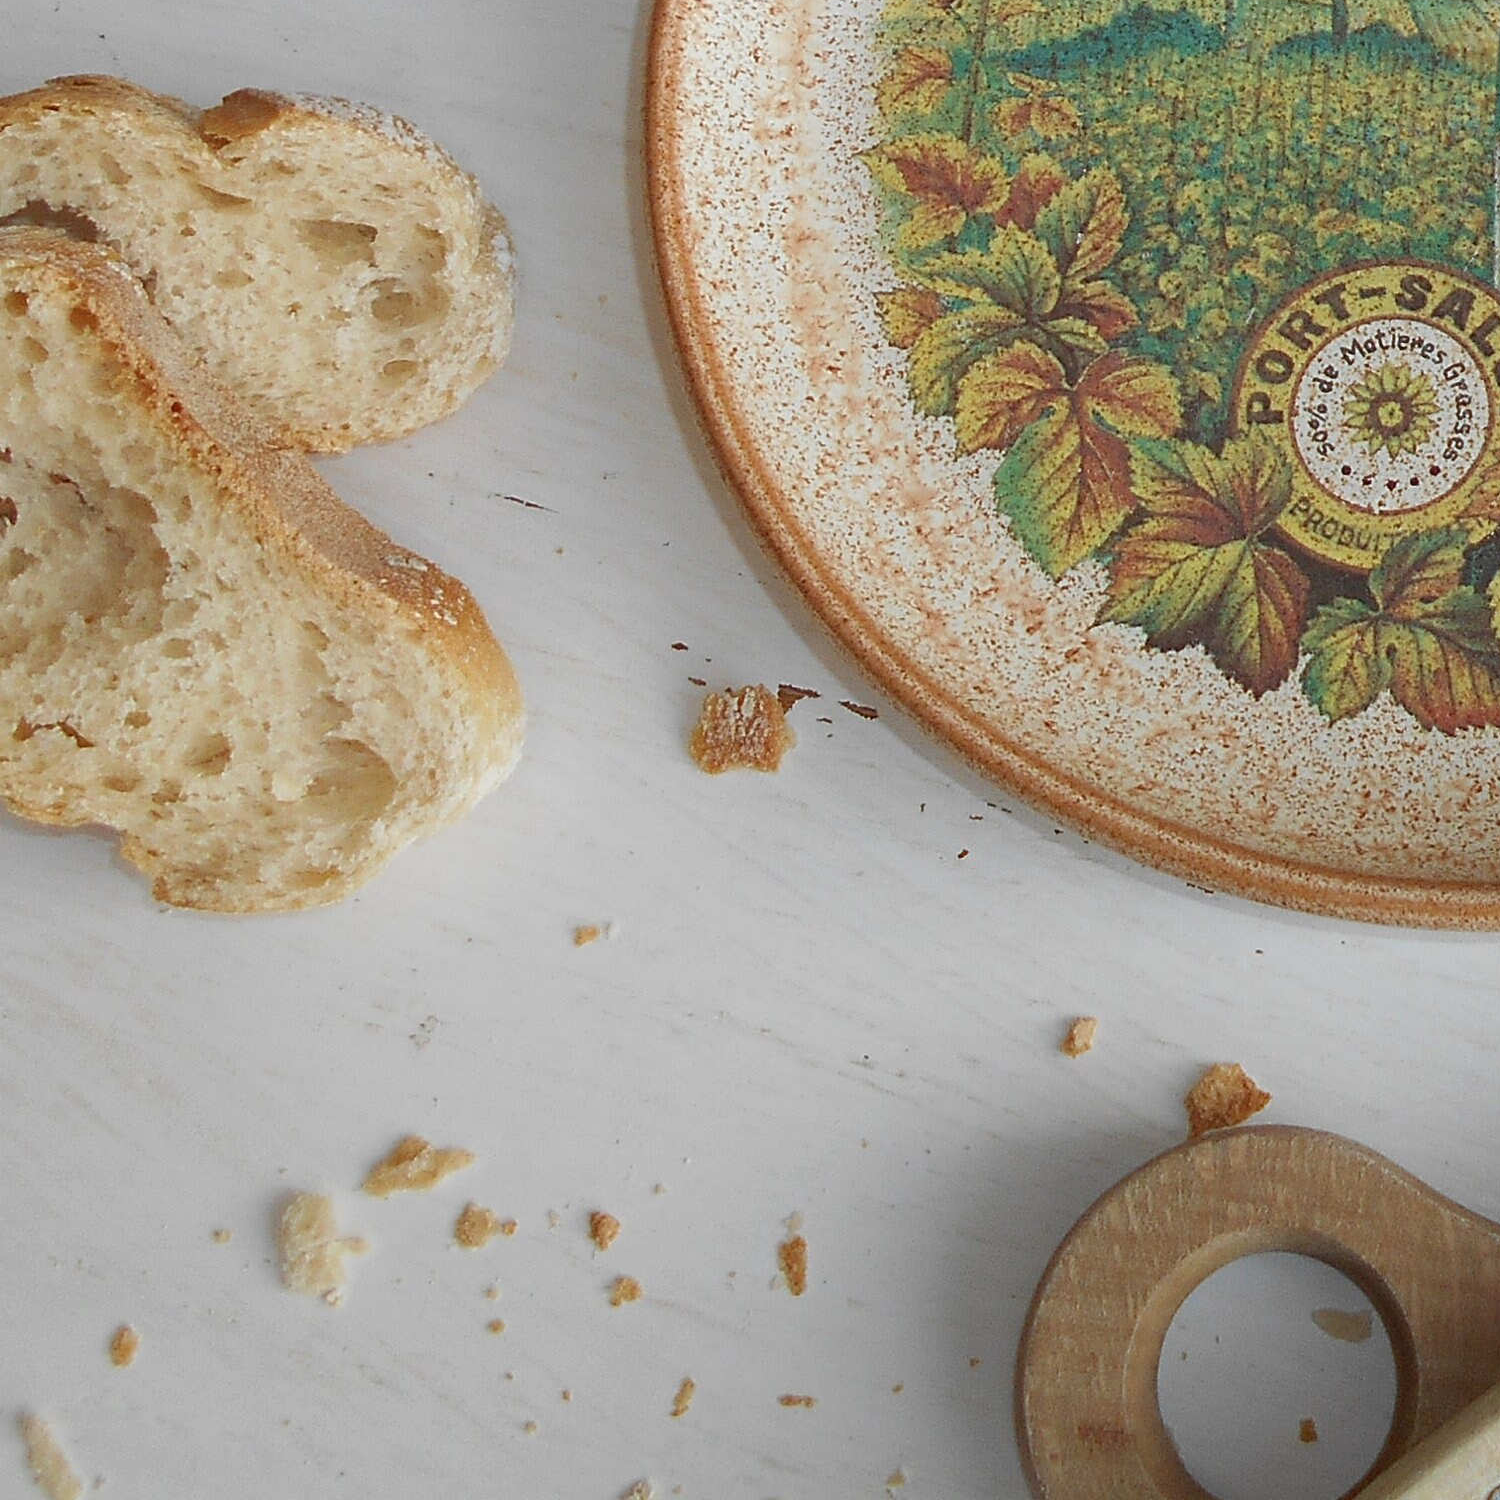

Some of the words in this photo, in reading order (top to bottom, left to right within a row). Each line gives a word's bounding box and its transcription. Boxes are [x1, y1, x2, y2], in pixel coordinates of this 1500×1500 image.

[1312, 363, 1340, 394] de
[1442, 362, 1472, 463] Grasses
[1289, 496, 1403, 551] PRODUIT
